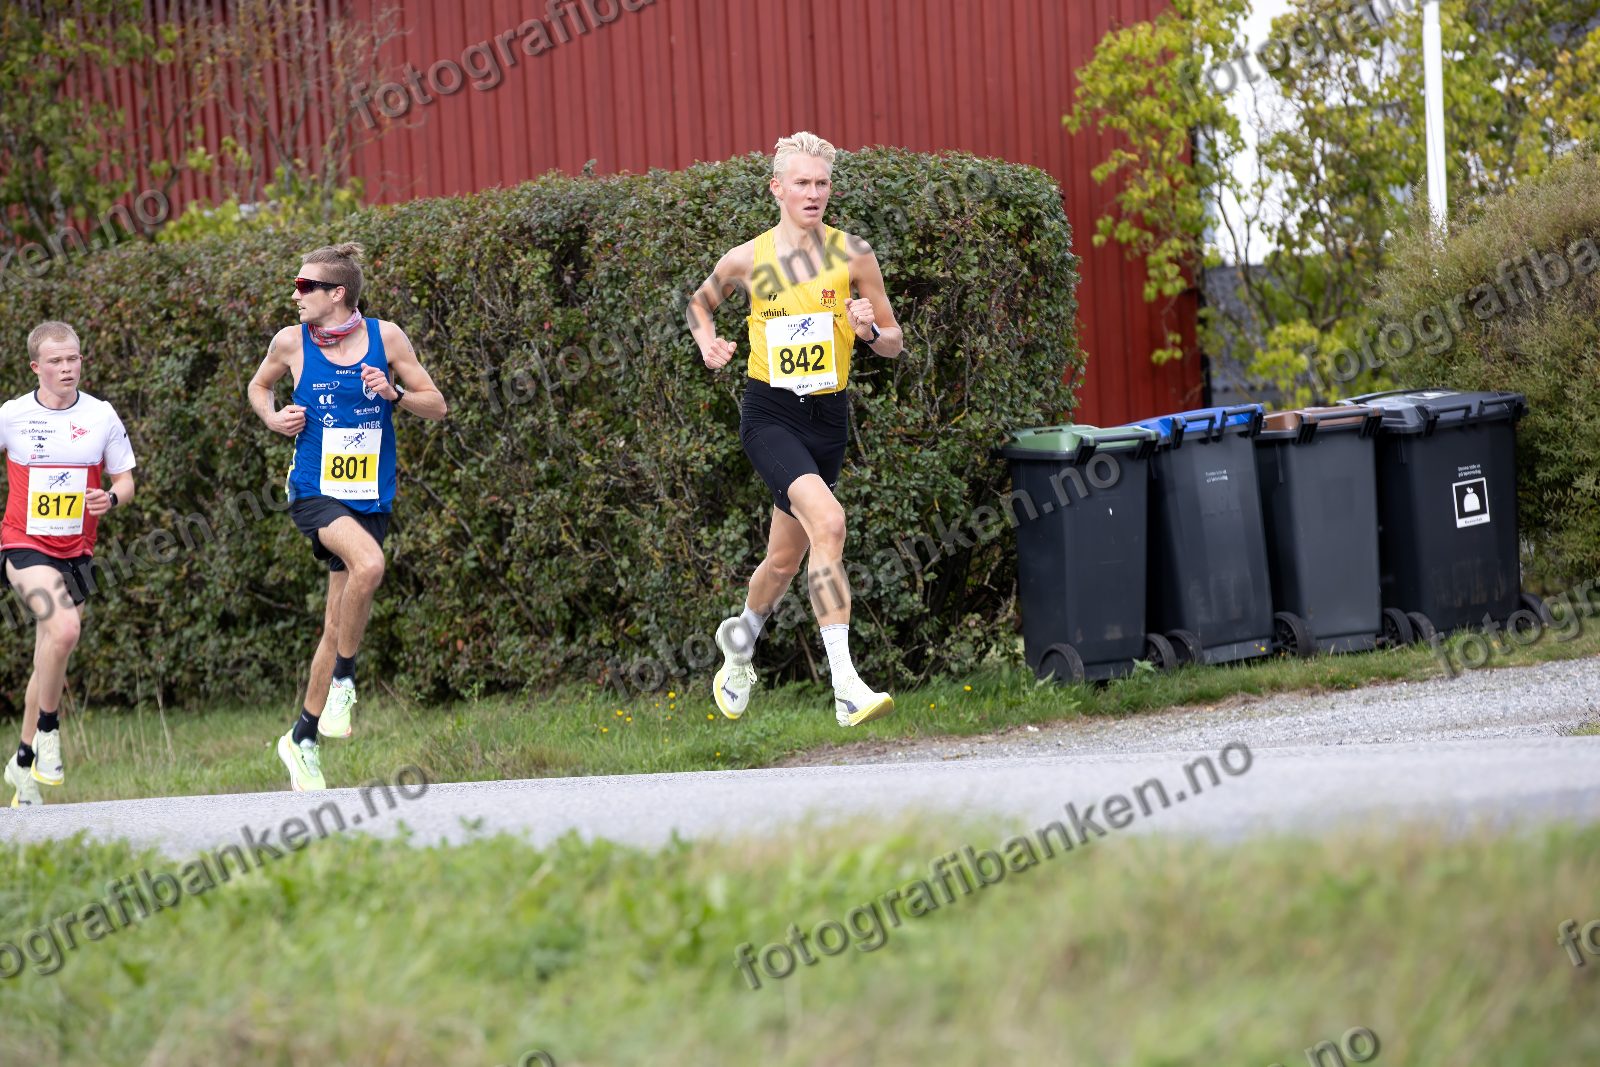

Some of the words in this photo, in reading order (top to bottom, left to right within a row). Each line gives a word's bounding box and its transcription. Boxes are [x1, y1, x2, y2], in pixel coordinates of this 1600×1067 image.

[779, 345, 825, 375] 842
[331, 456, 368, 479] 801
[37, 495, 77, 516] 817
